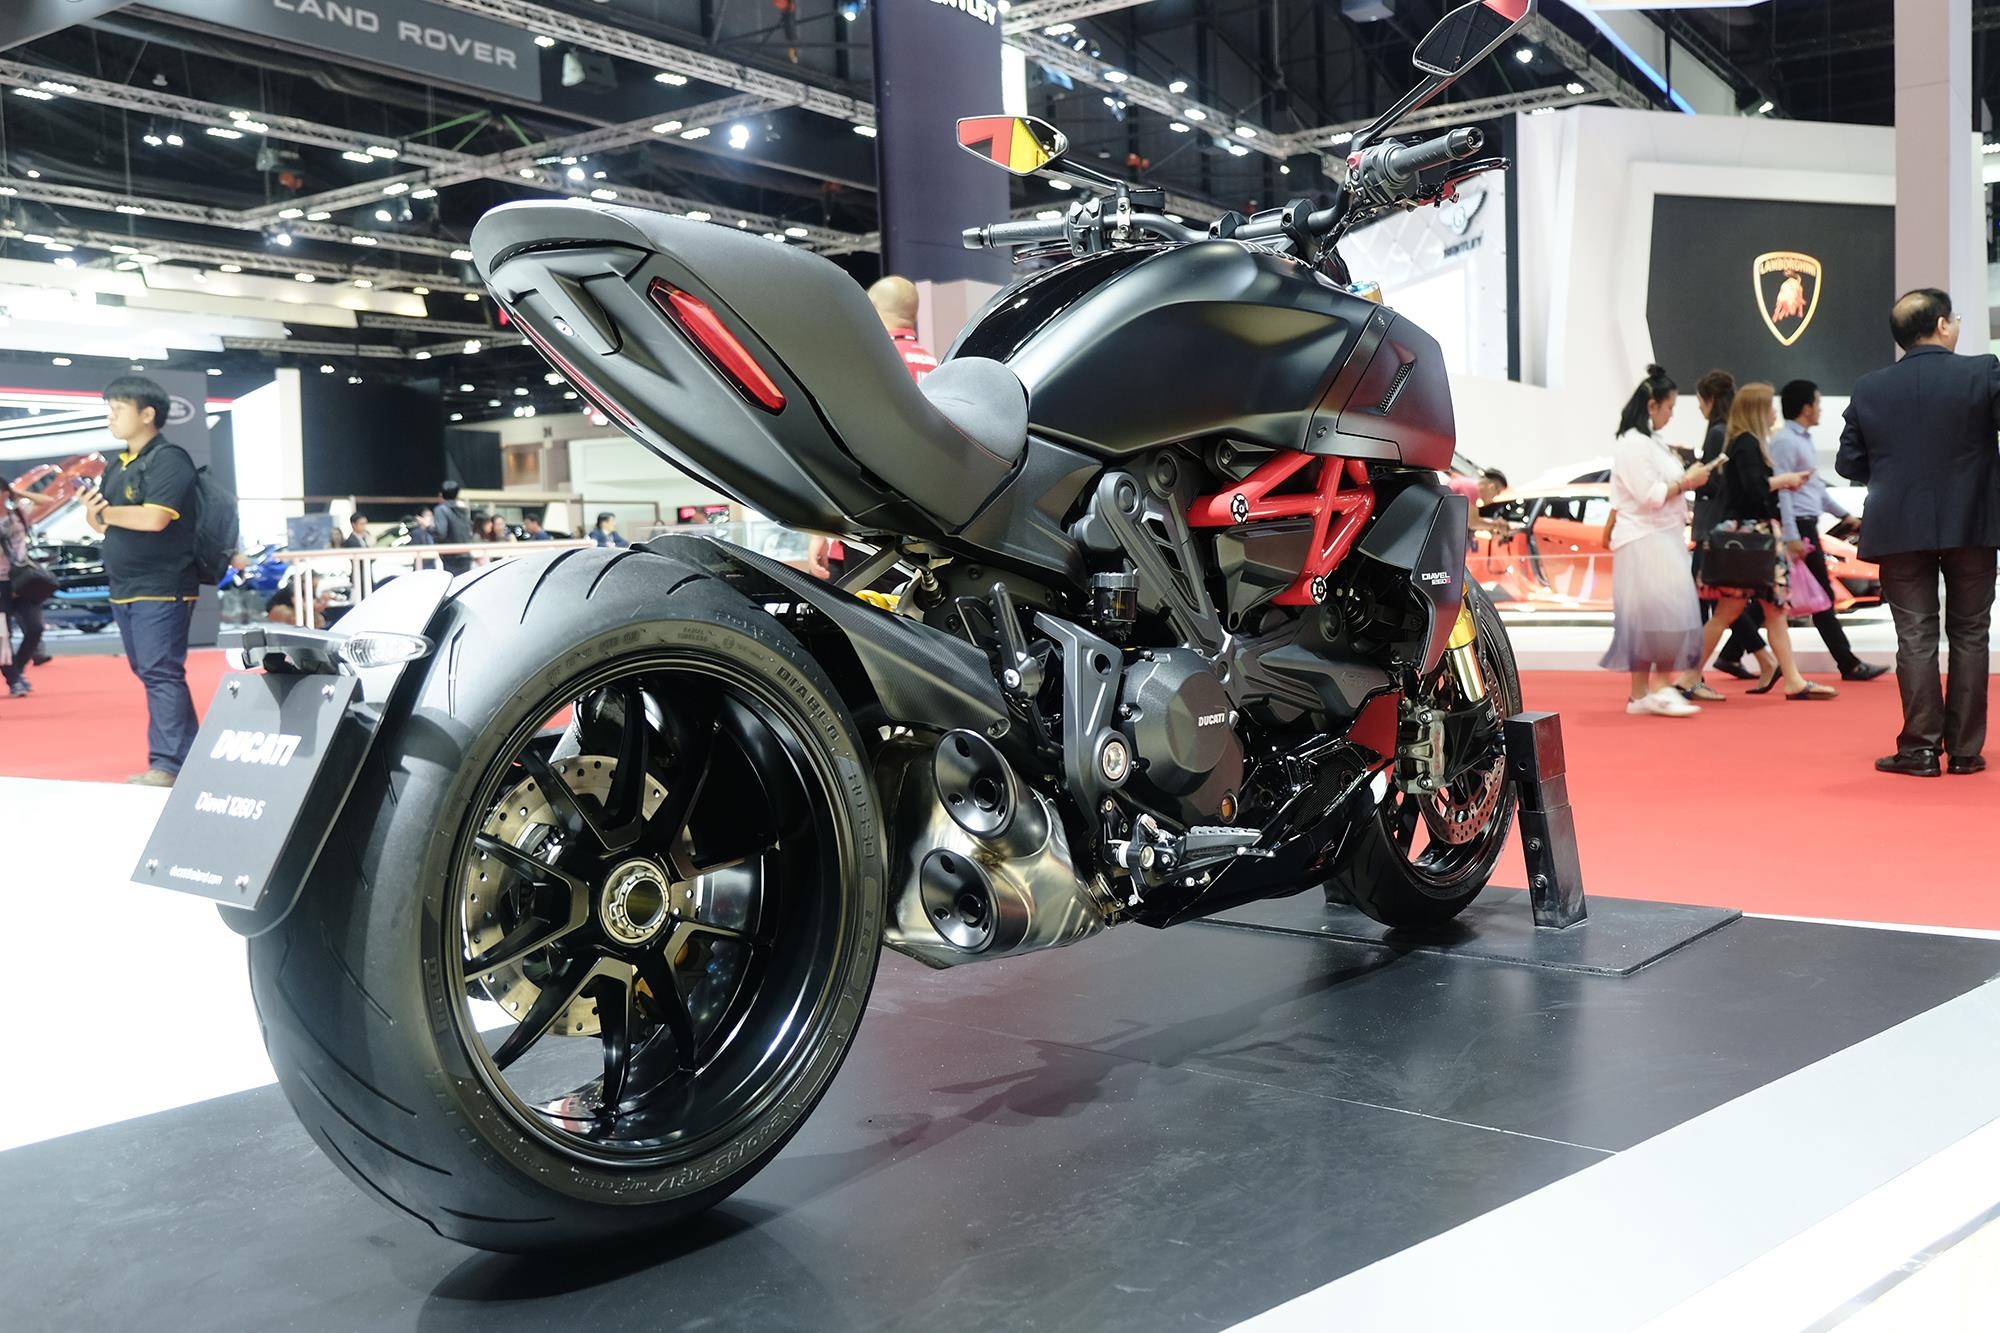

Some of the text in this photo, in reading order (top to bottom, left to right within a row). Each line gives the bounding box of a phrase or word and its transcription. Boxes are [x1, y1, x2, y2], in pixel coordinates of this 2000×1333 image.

[397, 20, 518, 71] ROVER
[1421, 571, 1450, 581] DIAVEL
[776, 665, 841, 742] DIABLO
[1198, 712, 1225, 727] DUCATI
[209, 729, 303, 767] DUCATI
[194, 791, 233, 815] Diavel
[251, 800, 267, 821] S
